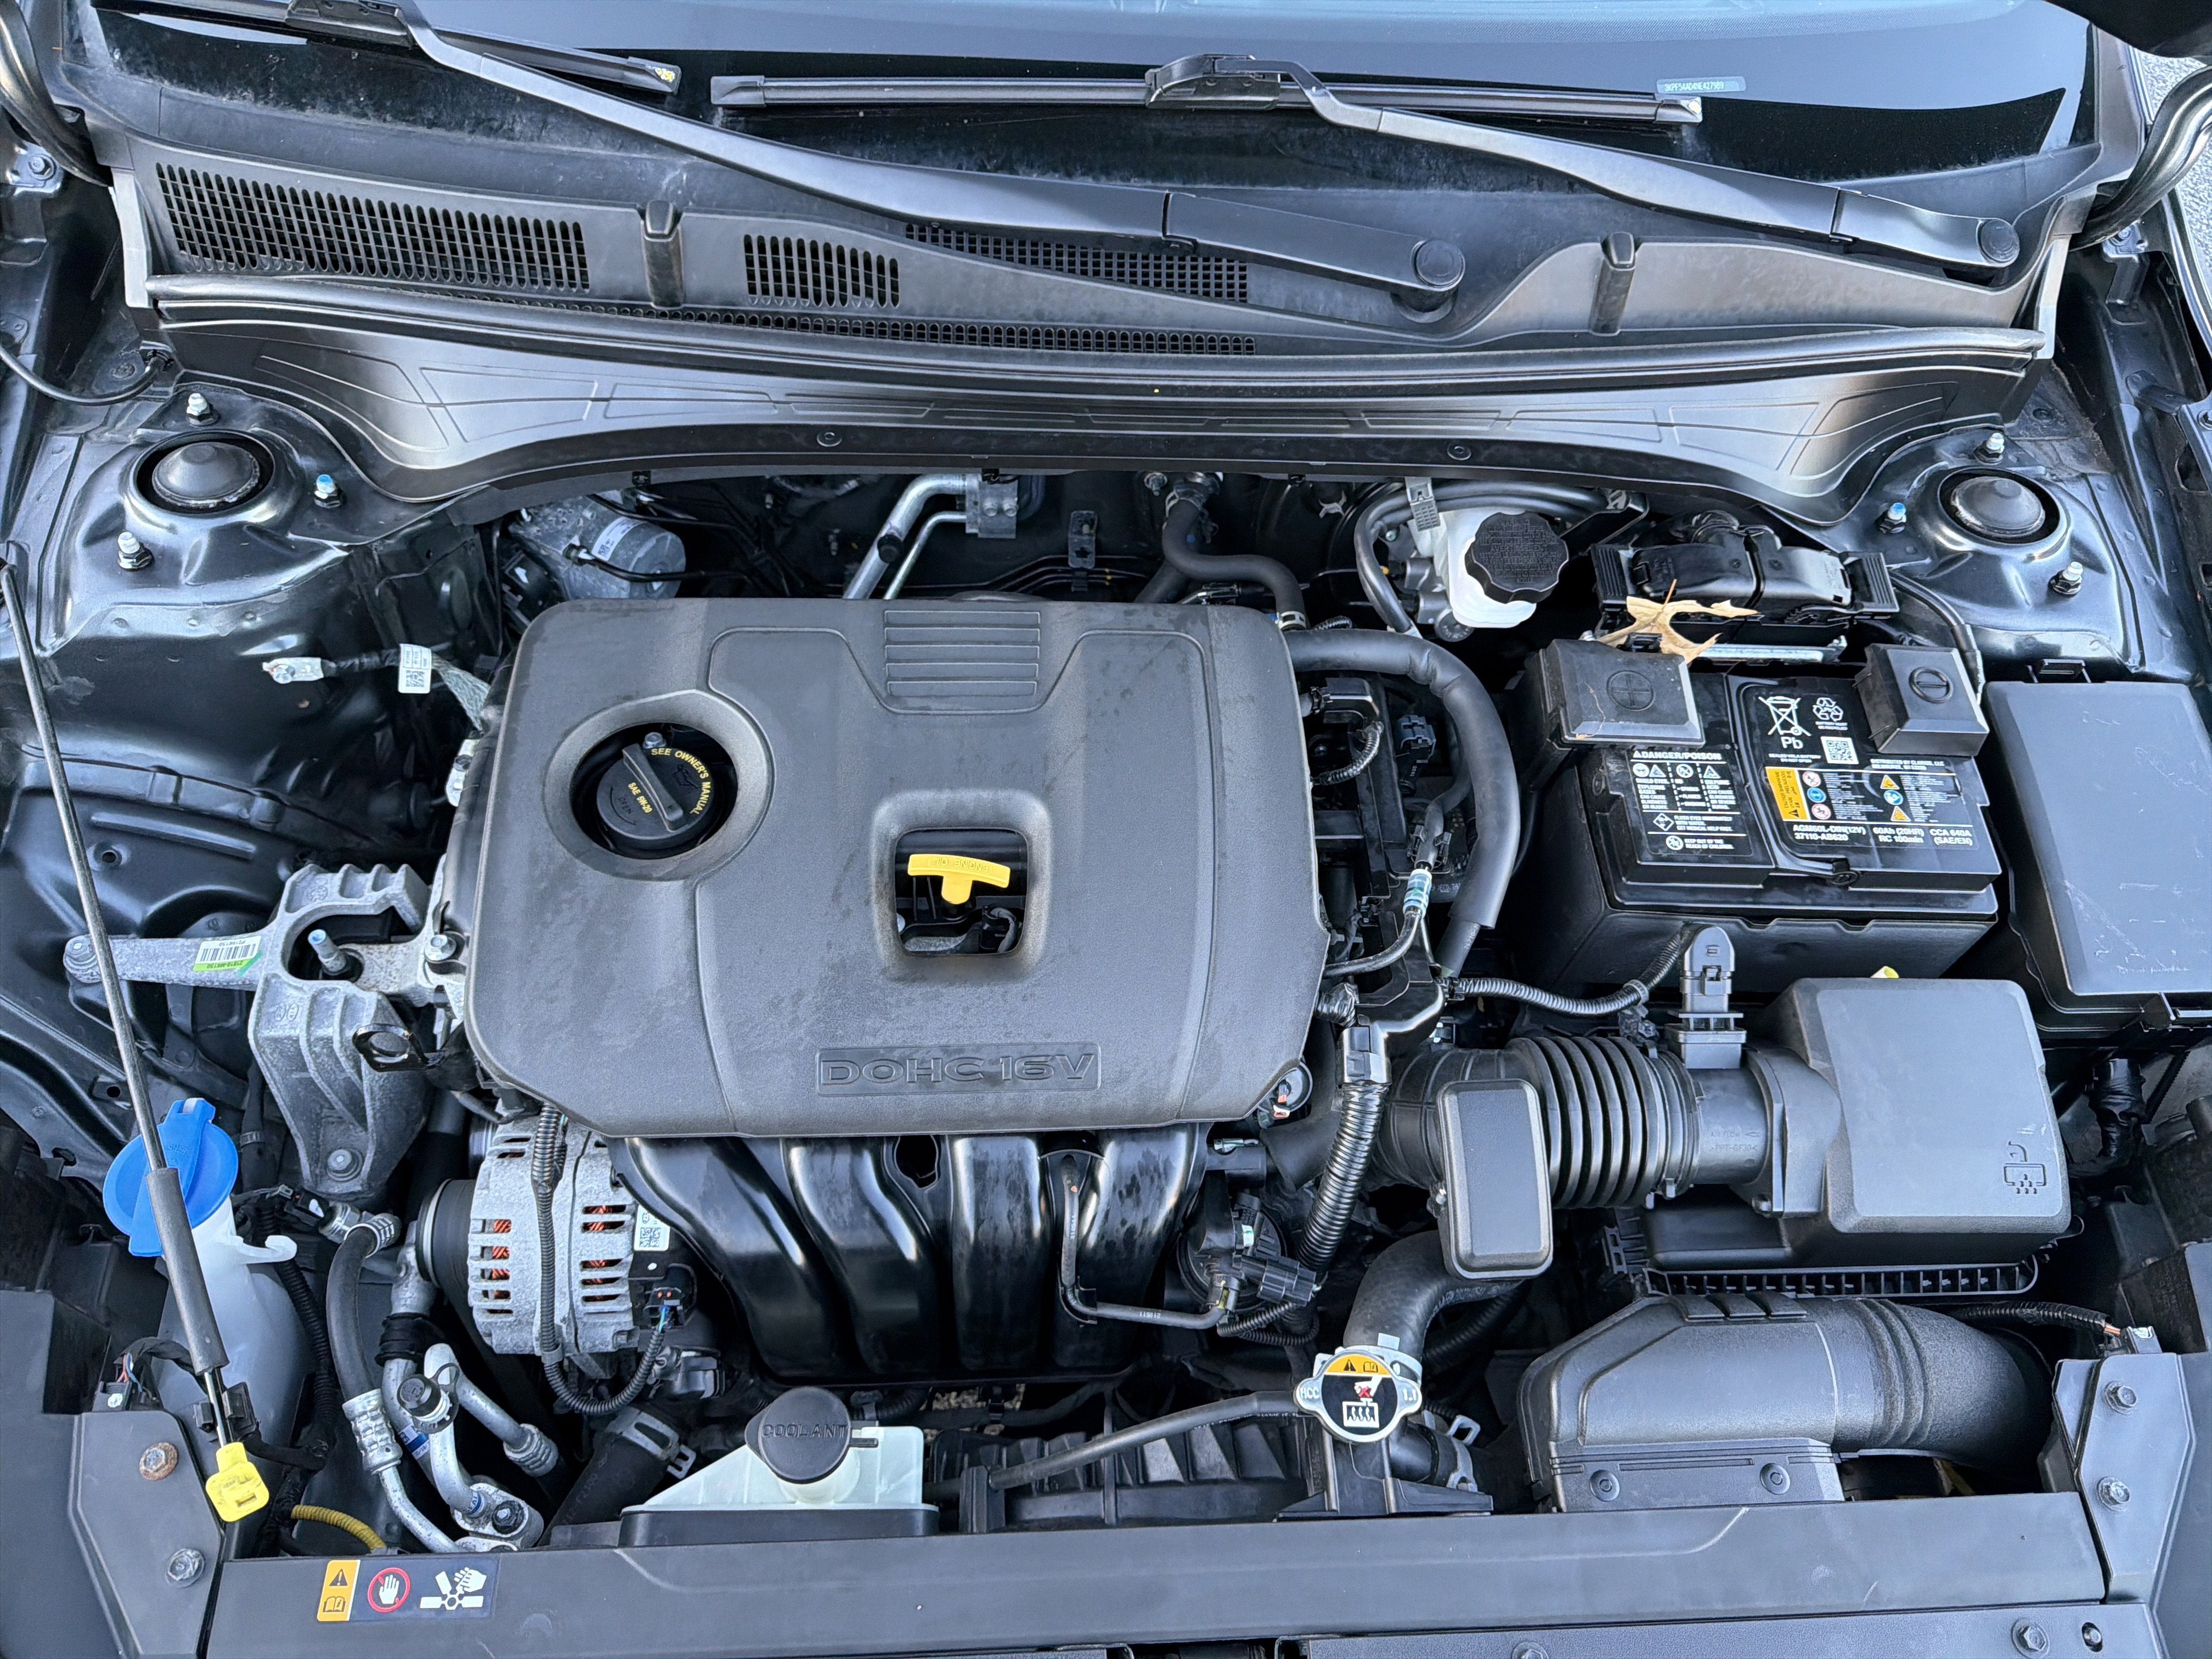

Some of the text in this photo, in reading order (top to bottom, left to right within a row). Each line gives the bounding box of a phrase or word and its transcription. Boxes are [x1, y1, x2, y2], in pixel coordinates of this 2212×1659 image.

[1781, 736, 1803, 749] Pb
[1641, 752, 1723, 760] DANGER/POISON
[675, 751, 709, 779] OWNER'S
[628, 782, 653, 813] SAE 5W-20
[690, 781, 711, 815] MANUAL
[934, 857, 989, 872] ENGINE OIL
[821, 1054, 1094, 1085] DOHC 16V
[1402, 1388, 1417, 1401] 1.1
[762, 1424, 847, 1438] COOLANT
